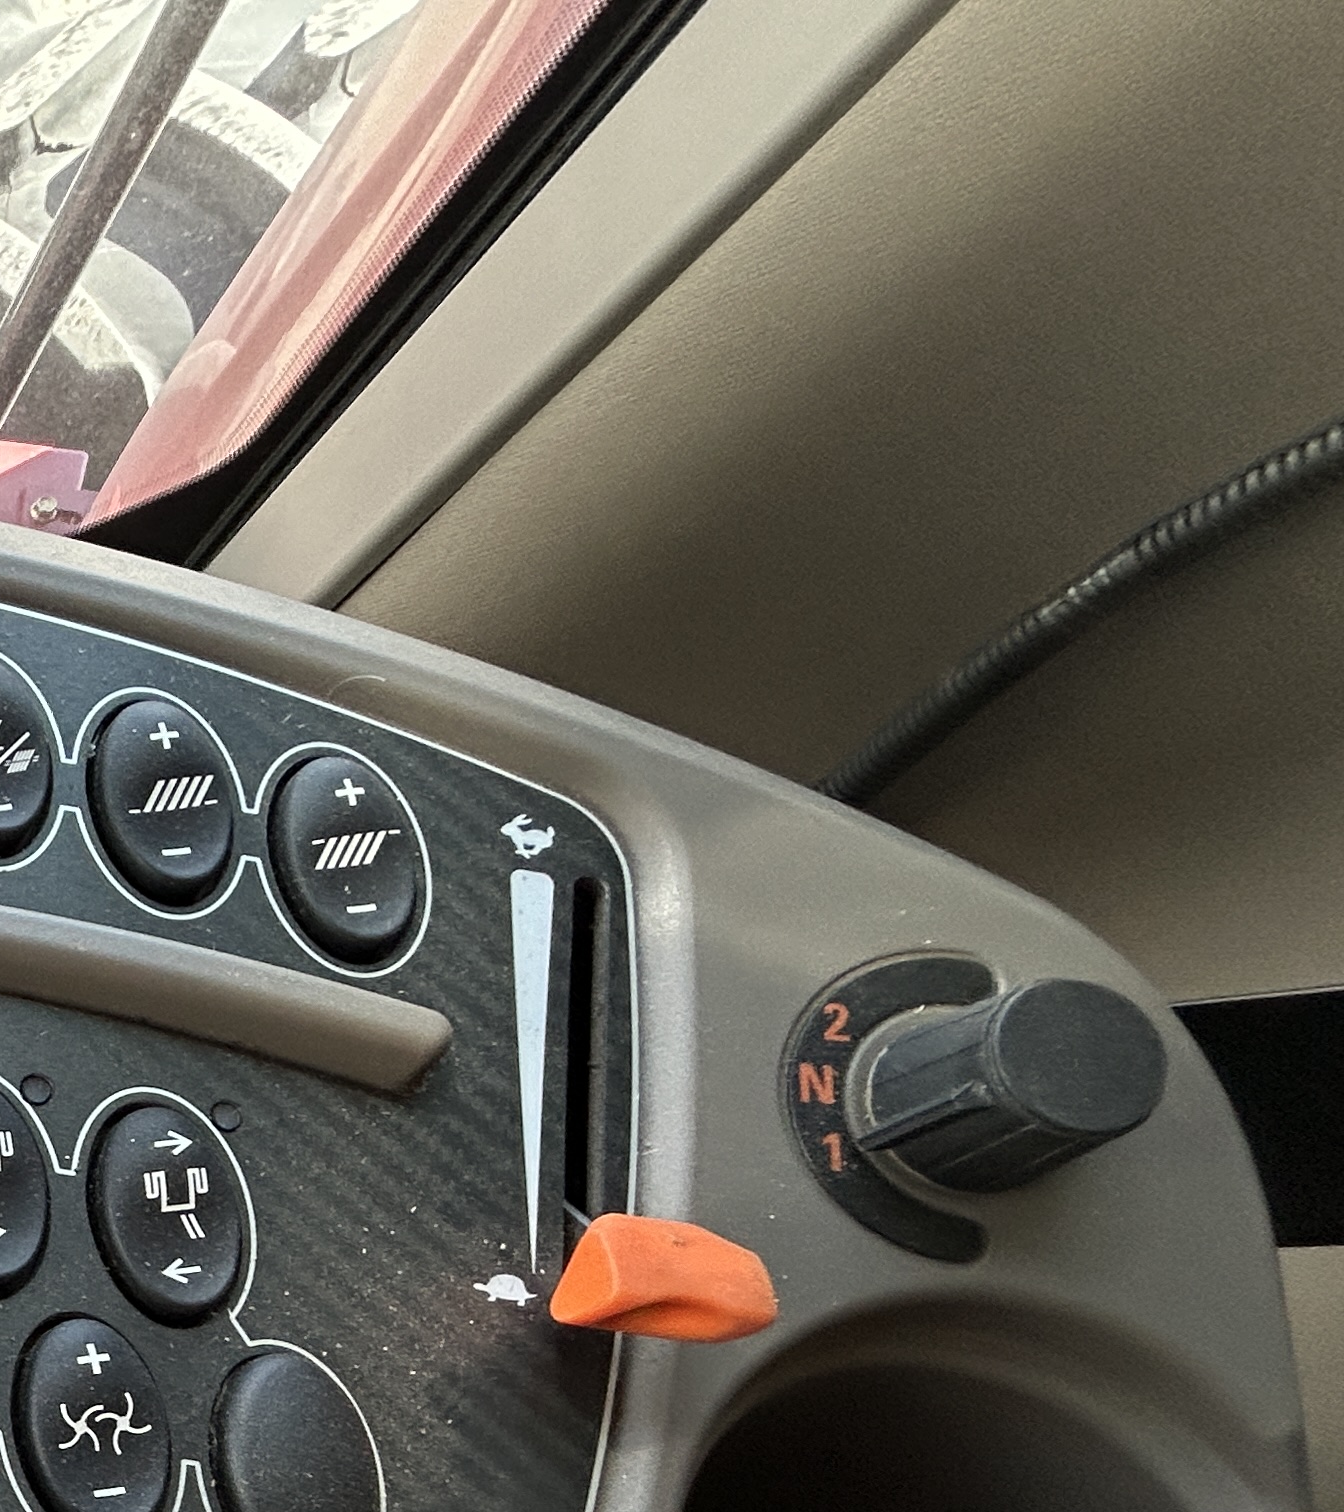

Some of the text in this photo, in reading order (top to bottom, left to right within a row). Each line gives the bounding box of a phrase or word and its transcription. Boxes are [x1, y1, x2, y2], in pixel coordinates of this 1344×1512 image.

[822, 1003, 851, 1042] 2
[798, 1063, 837, 1104] N
[821, 1132, 843, 1172] 1
